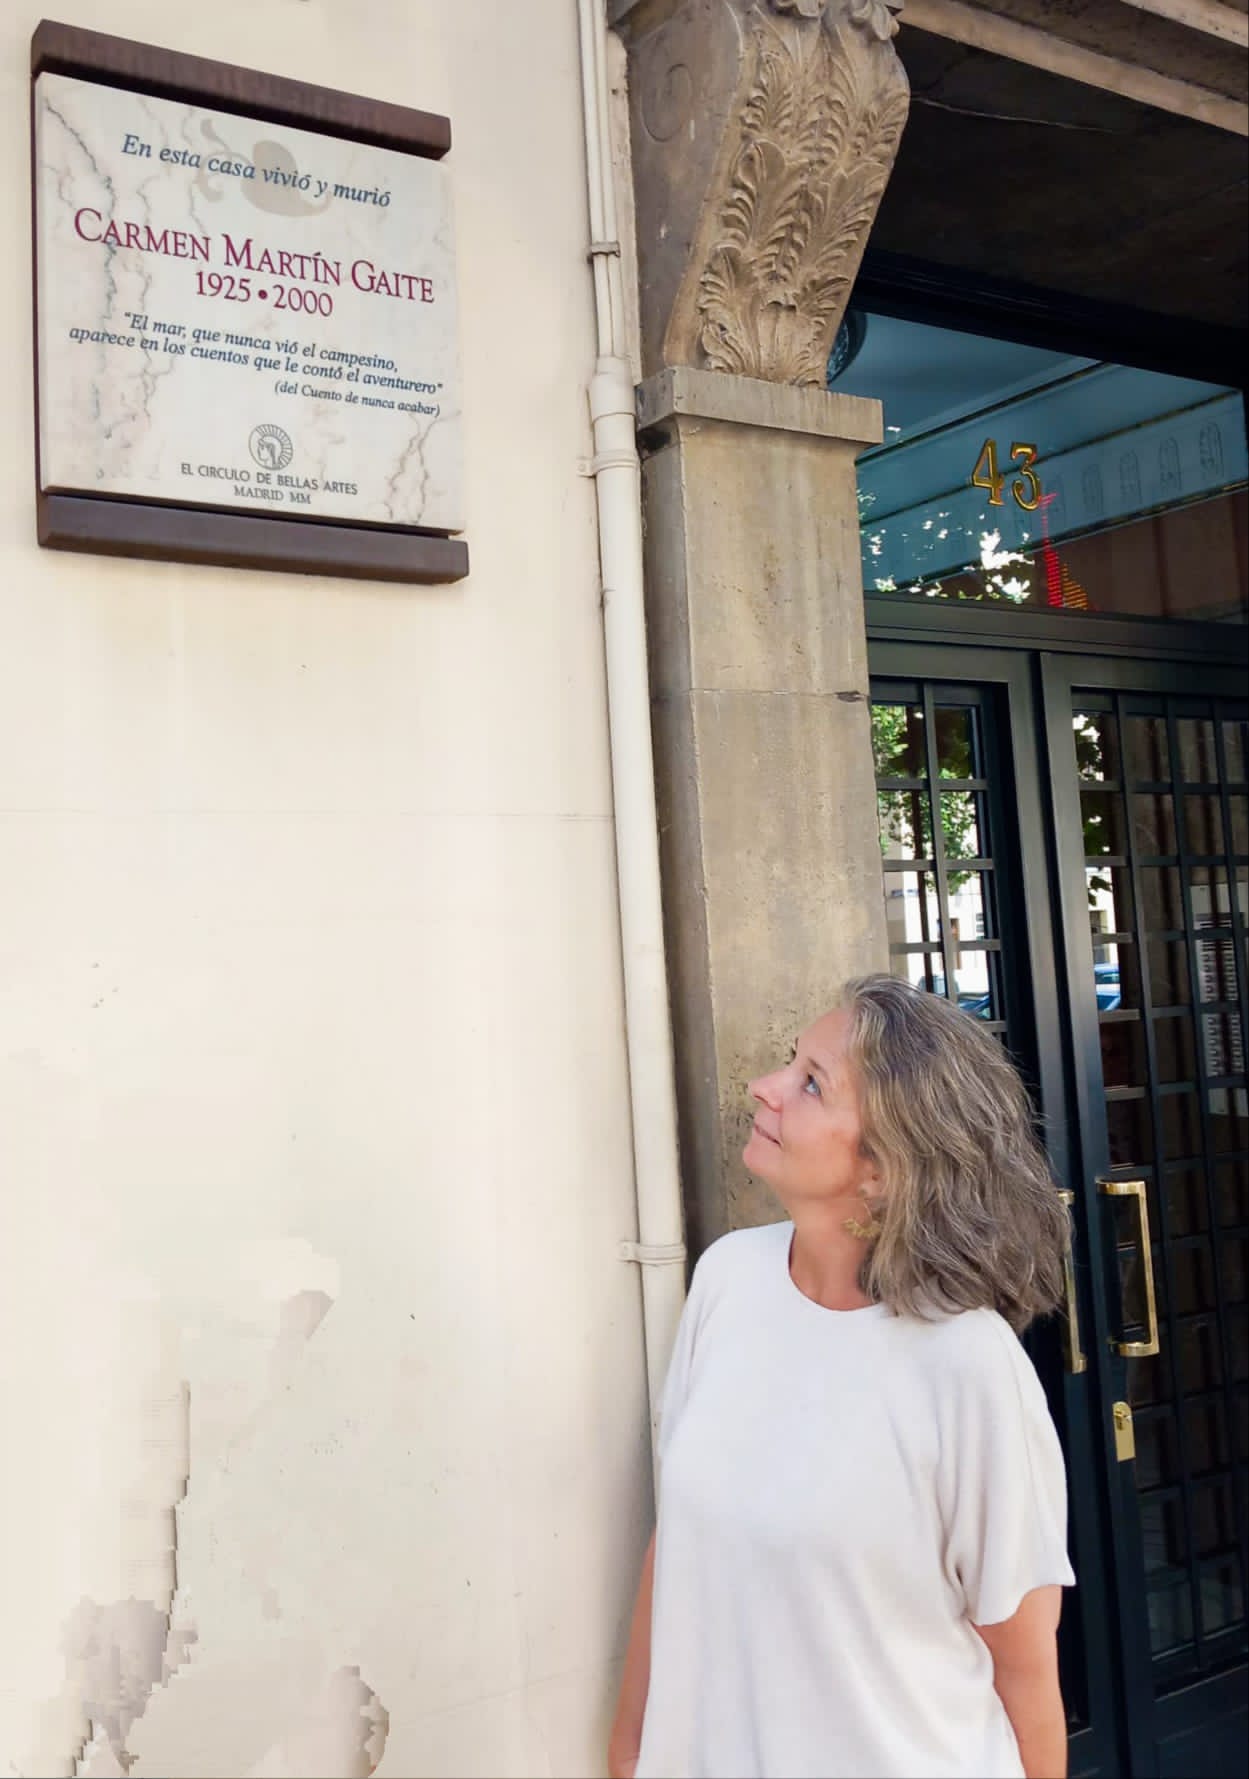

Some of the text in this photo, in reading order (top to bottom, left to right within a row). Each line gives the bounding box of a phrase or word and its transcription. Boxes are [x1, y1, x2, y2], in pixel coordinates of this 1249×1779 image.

[121, 133, 392, 208] En esta casa vivió y murió
[351, 259, 435, 303] GAITE
[69, 327, 135, 348] aparece
[140, 337, 159, 351] en
[163, 337, 186, 355] los
[190, 346, 249, 365] cuentos
[253, 355, 281, 372] que
[284, 357, 299, 372] le
[302, 363, 343, 380] contó
[346, 368, 360, 383] el
[152, 320, 187, 339] mar,
[192, 327, 221, 343] que
[225, 333, 271, 350] nunca
[275, 339, 298, 354] vió
[302, 343, 316, 358] el
[319, 349, 398, 373] campesino,
[274, 380, 441, 418] (del Cuento de nunca acabar)
[181, 463, 359, 495] EL CIRCULO DE BELLAS ARTES
[234, 485, 311, 504] MADRID MM
[970, 437, 1041, 511] 43
